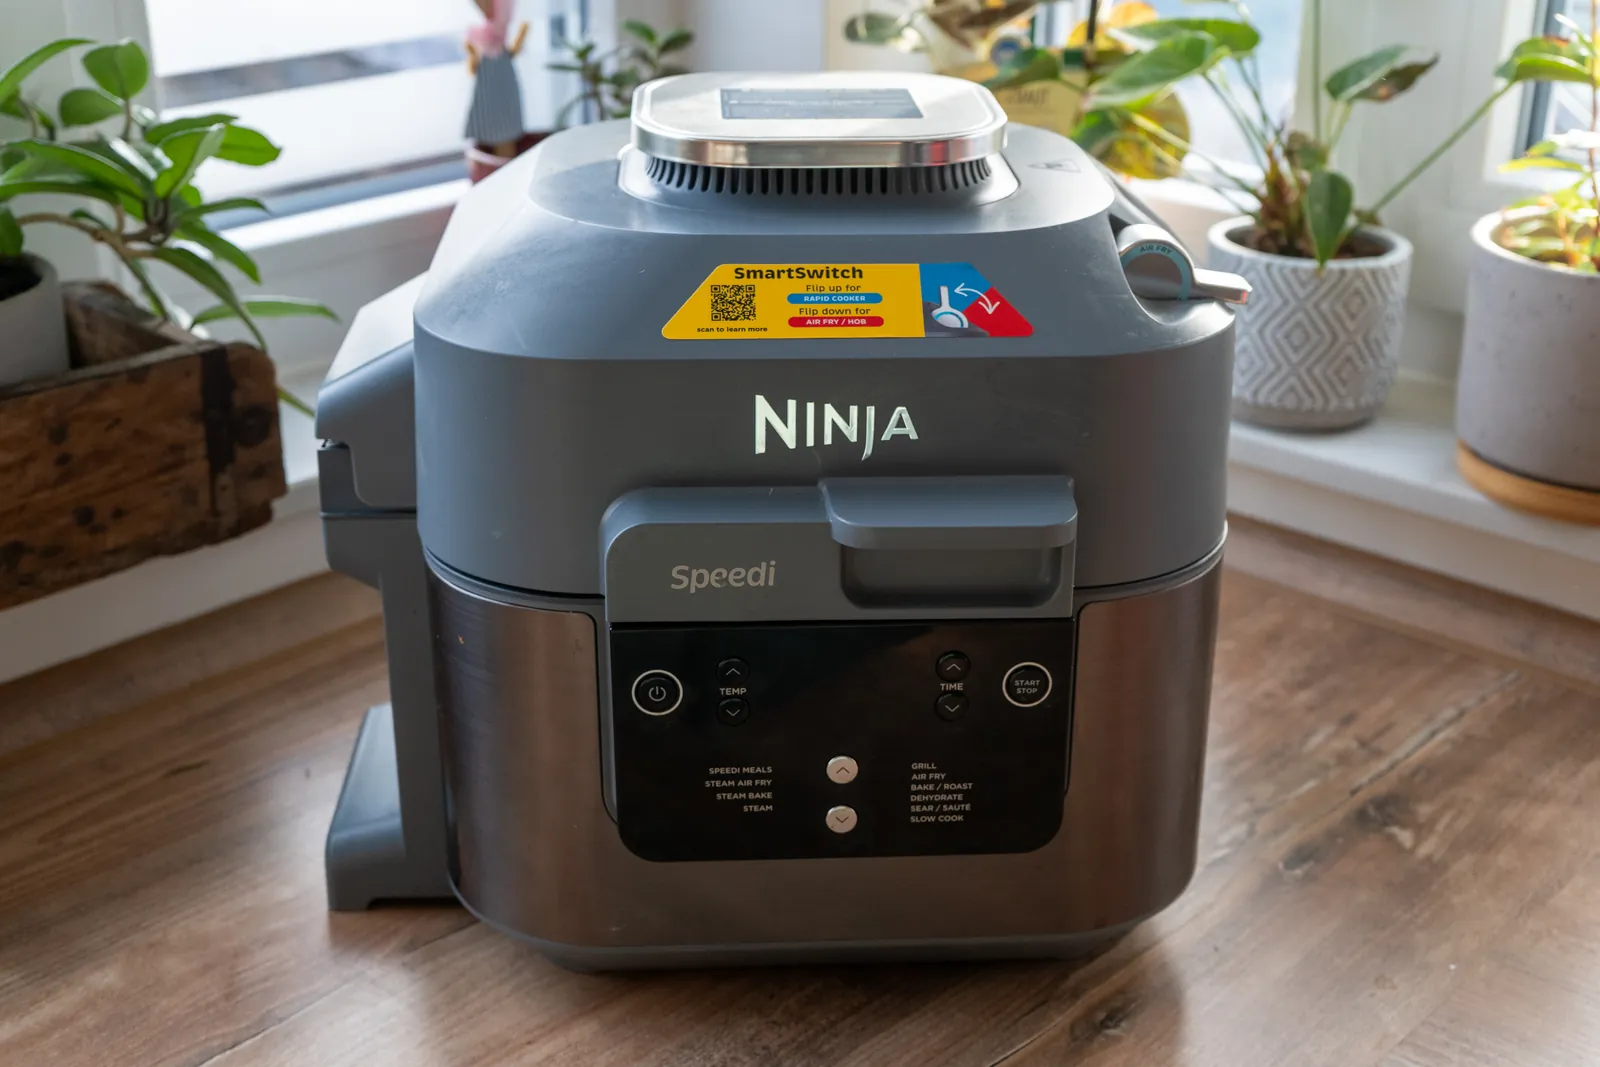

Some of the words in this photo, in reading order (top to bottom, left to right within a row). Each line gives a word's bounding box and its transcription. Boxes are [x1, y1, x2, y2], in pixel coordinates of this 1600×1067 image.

[1140, 244, 1154, 253] AIR
[1155, 245, 1172, 254] FRY
[734, 266, 864, 280] SmartSwitch
[806, 284, 825, 293] Flip
[828, 285, 842, 293] up
[845, 284, 861, 292] for
[799, 307, 819, 316] Flip
[821, 307, 852, 315] down
[855, 307, 871, 315] for
[840, 318, 846, 326] /
[754, 394, 919, 461] NINJA
[670, 560, 777, 593] Speedi
[939, 682, 964, 691] TIME
[719, 687, 747, 696] TEMP
[708, 767, 740, 775] SPEEDI
[742, 766, 773, 774] MEALS
[911, 762, 937, 770] GRILL
[928, 772, 947, 780] FRY
[704, 779, 735, 788] STEAM
[737, 779, 753, 787] AIR
[754, 779, 772, 787] FRY
[910, 783, 935, 791] BAKE
[936, 783, 942, 791] /
[943, 782, 974, 790] ROAST
[716, 792, 746, 800] STEAM
[748, 791, 773, 800] BAKE
[910, 793, 964, 802] DEHYDRATE
[743, 804, 773, 812] STEAM
[910, 804, 934, 813] SEAR
[935, 804, 941, 812] /
[910, 815, 936, 823] SLOW
[937, 814, 964, 823] COOK
